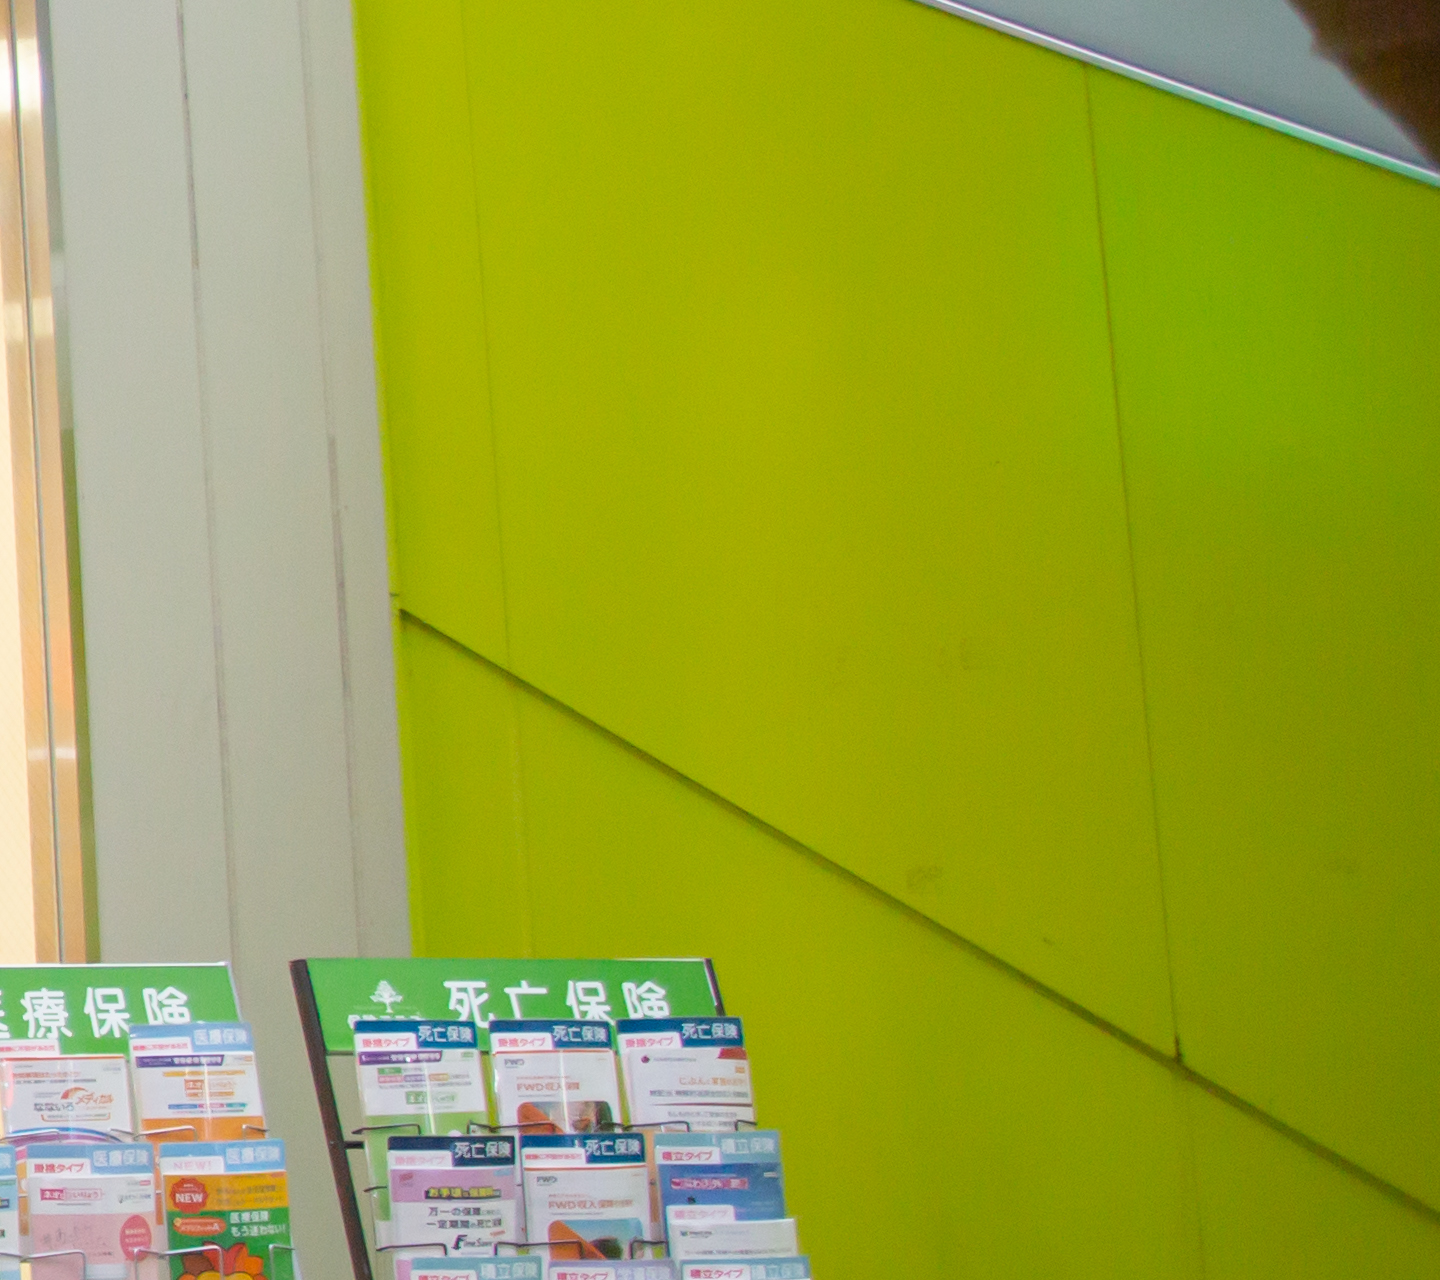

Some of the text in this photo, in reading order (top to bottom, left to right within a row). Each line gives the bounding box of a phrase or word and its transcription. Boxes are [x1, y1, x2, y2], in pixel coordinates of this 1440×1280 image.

[443, 979, 671, 1028] 死亡保険
[194, 1029, 248, 1045] 医療保険
[418, 1026, 474, 1042] 死亡保険
[552, 1024, 609, 1043] 死亡保険
[682, 1023, 739, 1039] 死亡保険
[455, 1141, 513, 1158] 死亡保険
[586, 1139, 642, 1155] 死亡保険
[93, 1150, 149, 1166] 医療保険
[226, 1147, 280, 1164] 医療保険
[173, 1160, 212, 1170] NEW!
[176, 1193, 203, 1203] NEW
